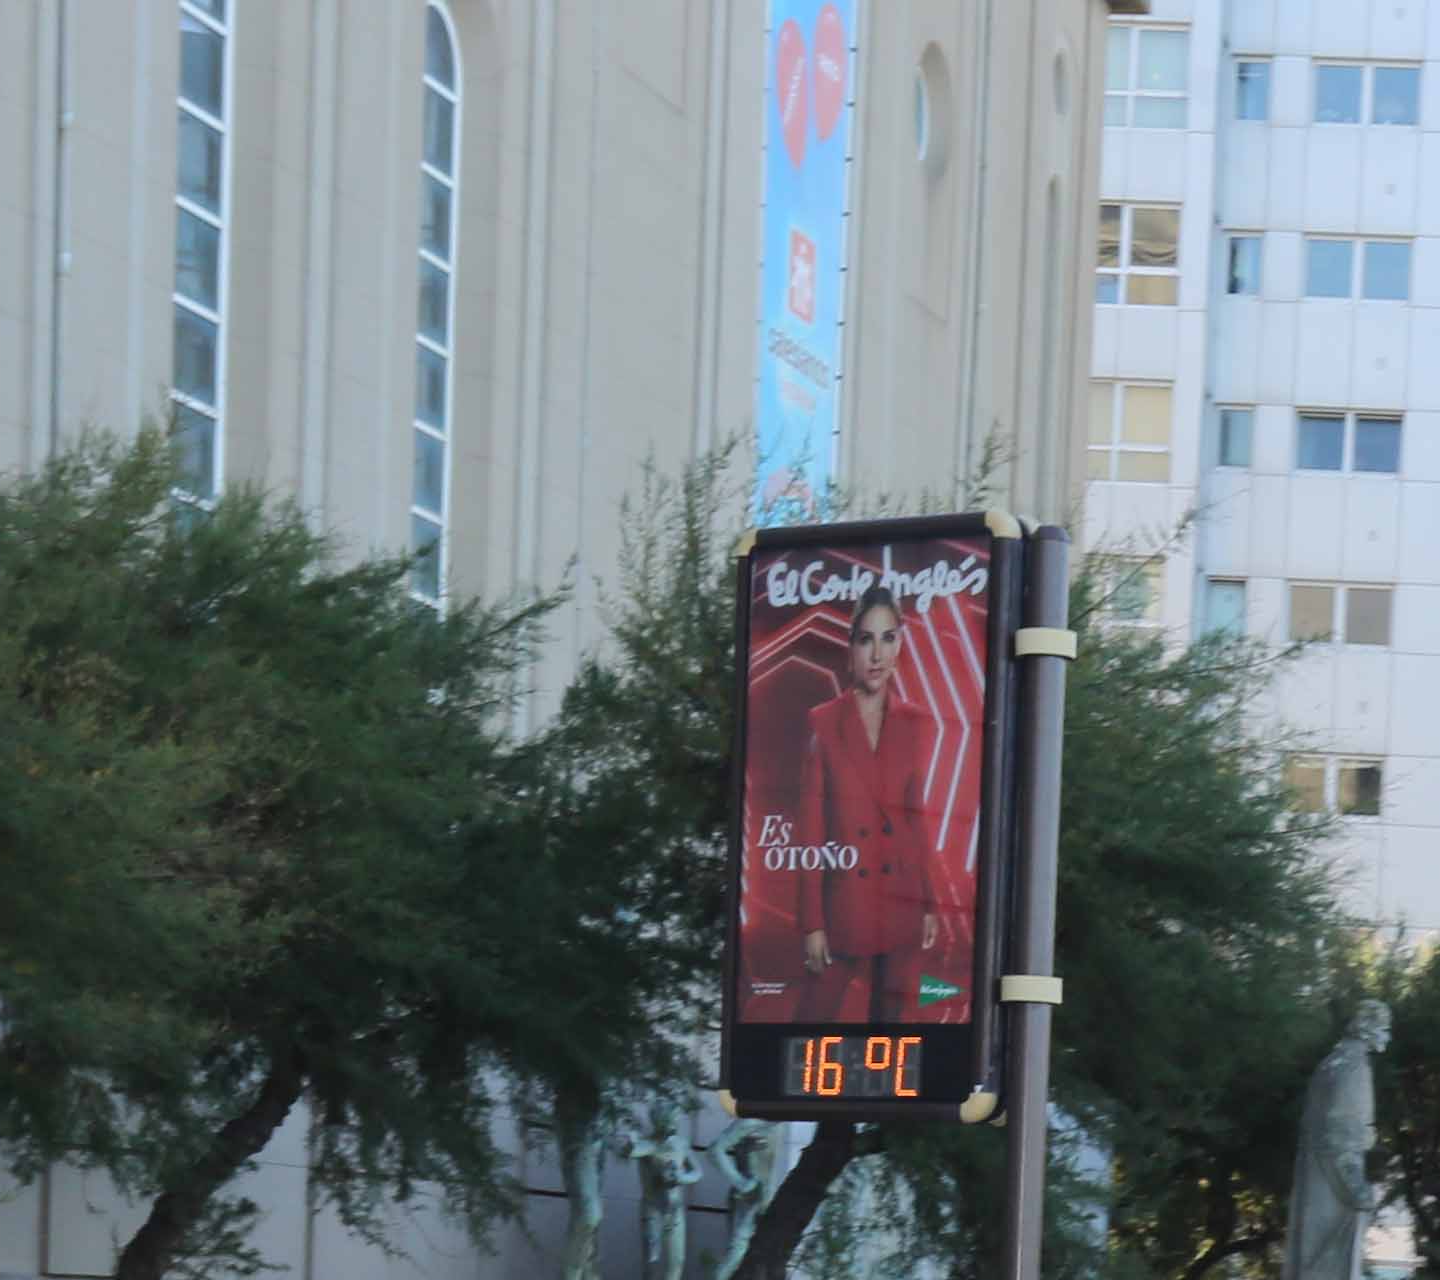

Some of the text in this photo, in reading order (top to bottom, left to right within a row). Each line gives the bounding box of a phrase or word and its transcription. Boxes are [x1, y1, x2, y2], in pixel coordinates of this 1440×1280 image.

[767, 545, 988, 614] El Corte Inglés
[757, 815, 792, 847] Es
[764, 841, 859, 871] OTOÑO
[803, 1036, 845, 1095] 16
